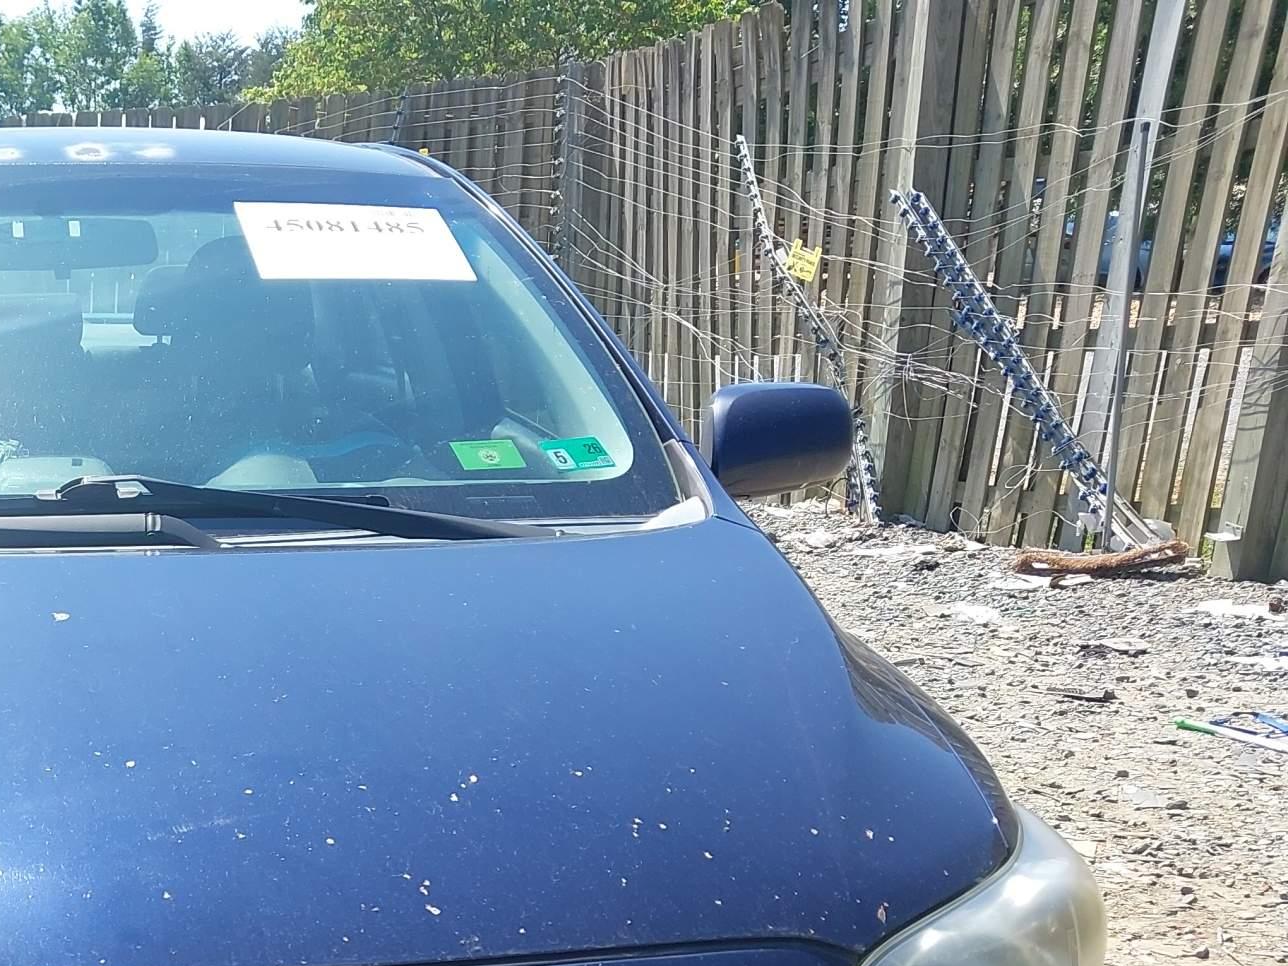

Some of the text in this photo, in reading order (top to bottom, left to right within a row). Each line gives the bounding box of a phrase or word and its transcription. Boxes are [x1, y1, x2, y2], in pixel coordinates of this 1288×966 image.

[266, 219, 426, 235] 45081485
[584, 443, 602, 454] 26
[553, 451, 568, 464] 5
